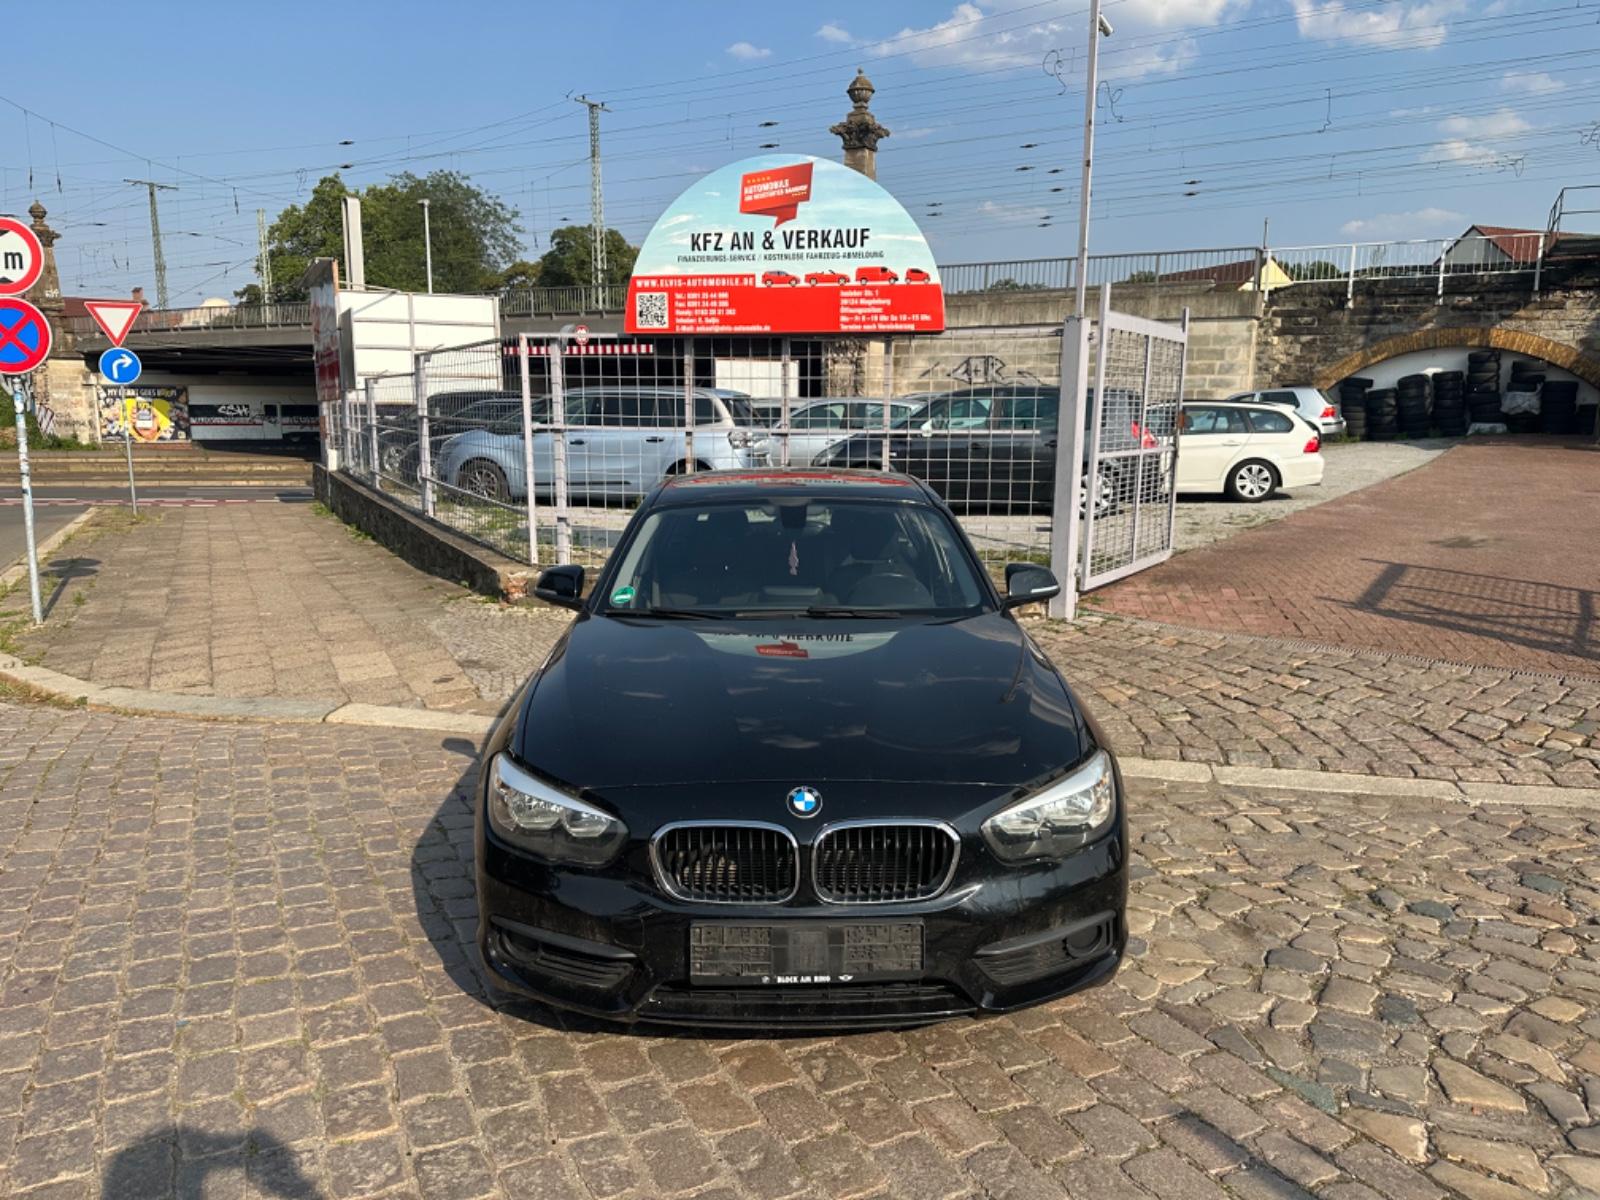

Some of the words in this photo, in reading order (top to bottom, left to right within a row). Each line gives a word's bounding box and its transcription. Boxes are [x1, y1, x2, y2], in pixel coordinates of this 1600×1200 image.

[691, 232, 723, 251] KFZ
[730, 231, 754, 250] AN
[762, 230, 775, 250] &
[783, 228, 870, 249] VERKAUF
[4, 252, 24, 270] m
[678, 253, 755, 262] FINANZIERUNGS-SERVICE
[763, 252, 803, 261] KOSTENLOSE
[806, 250, 884, 260] FAHRZEUG-ABMELDUNG
[636, 277, 754, 288] WWW.ELVIS-AUTOMOBILE.DE
